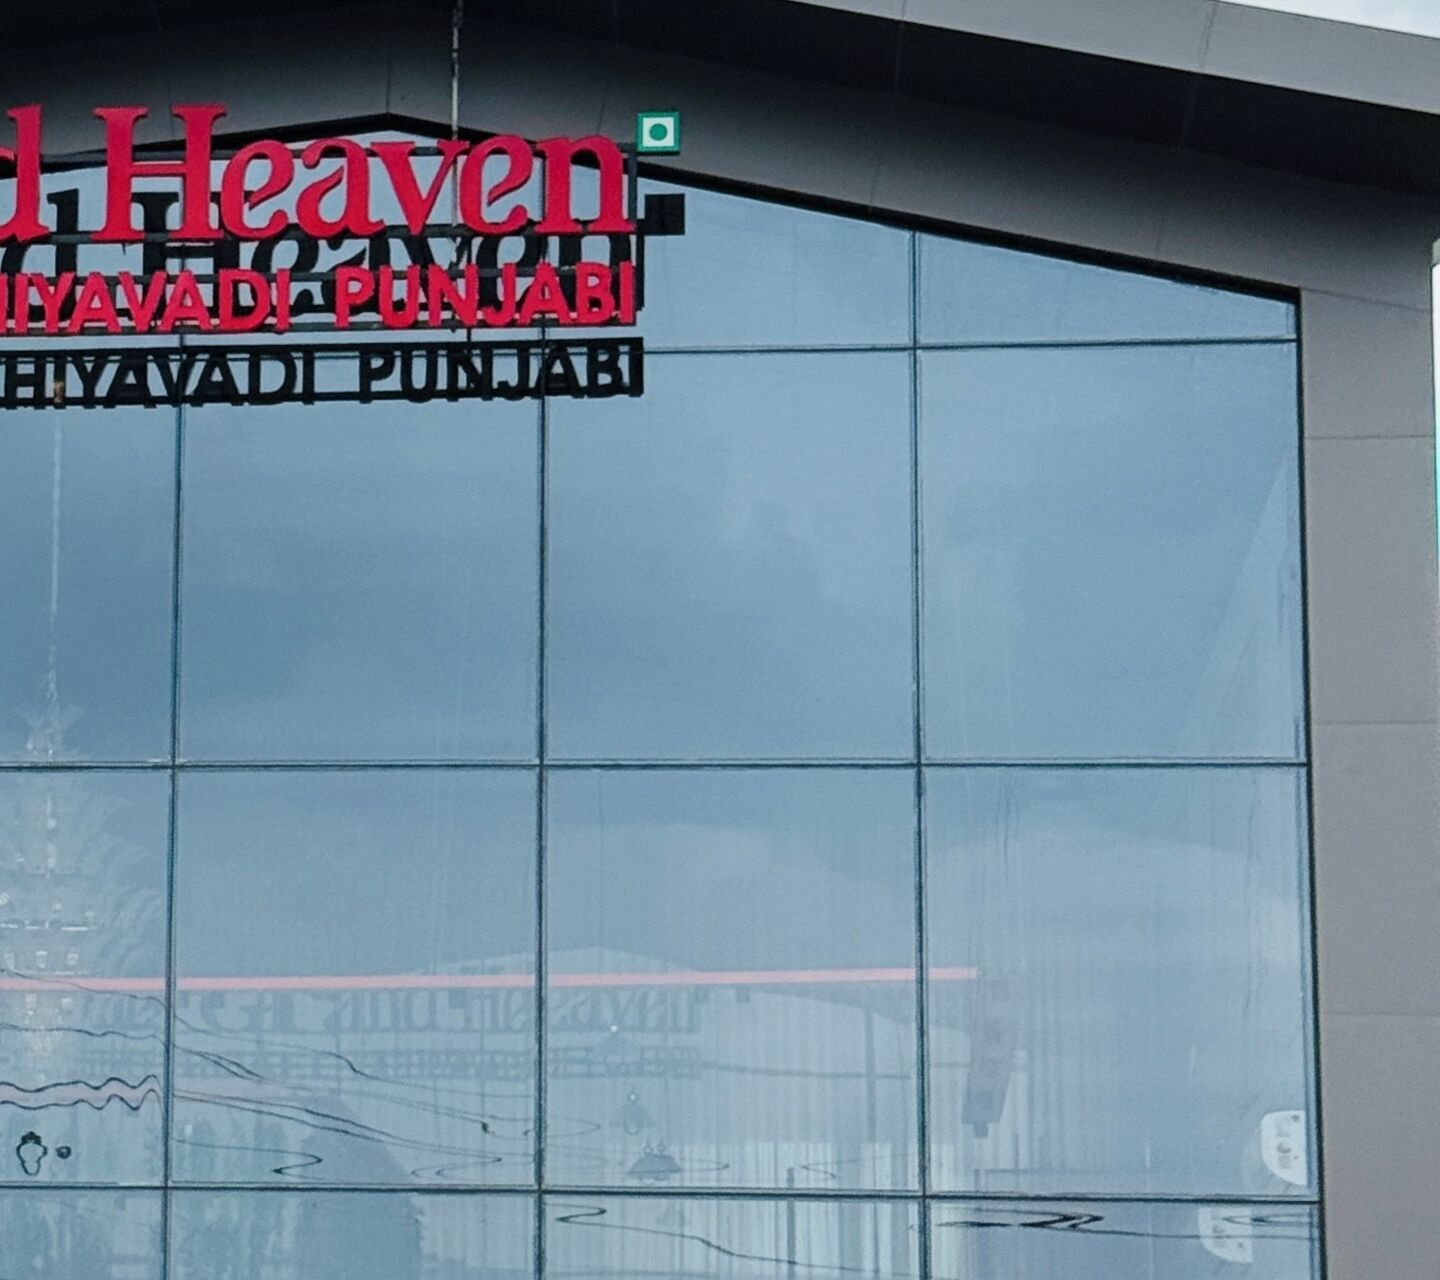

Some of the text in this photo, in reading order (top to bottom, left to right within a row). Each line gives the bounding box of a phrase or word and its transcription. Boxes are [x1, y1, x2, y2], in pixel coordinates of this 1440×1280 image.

[91, 103, 637, 242] Heaven
[333, 260, 636, 330] PUNJABI
[359, 339, 644, 402] PUNJABI
